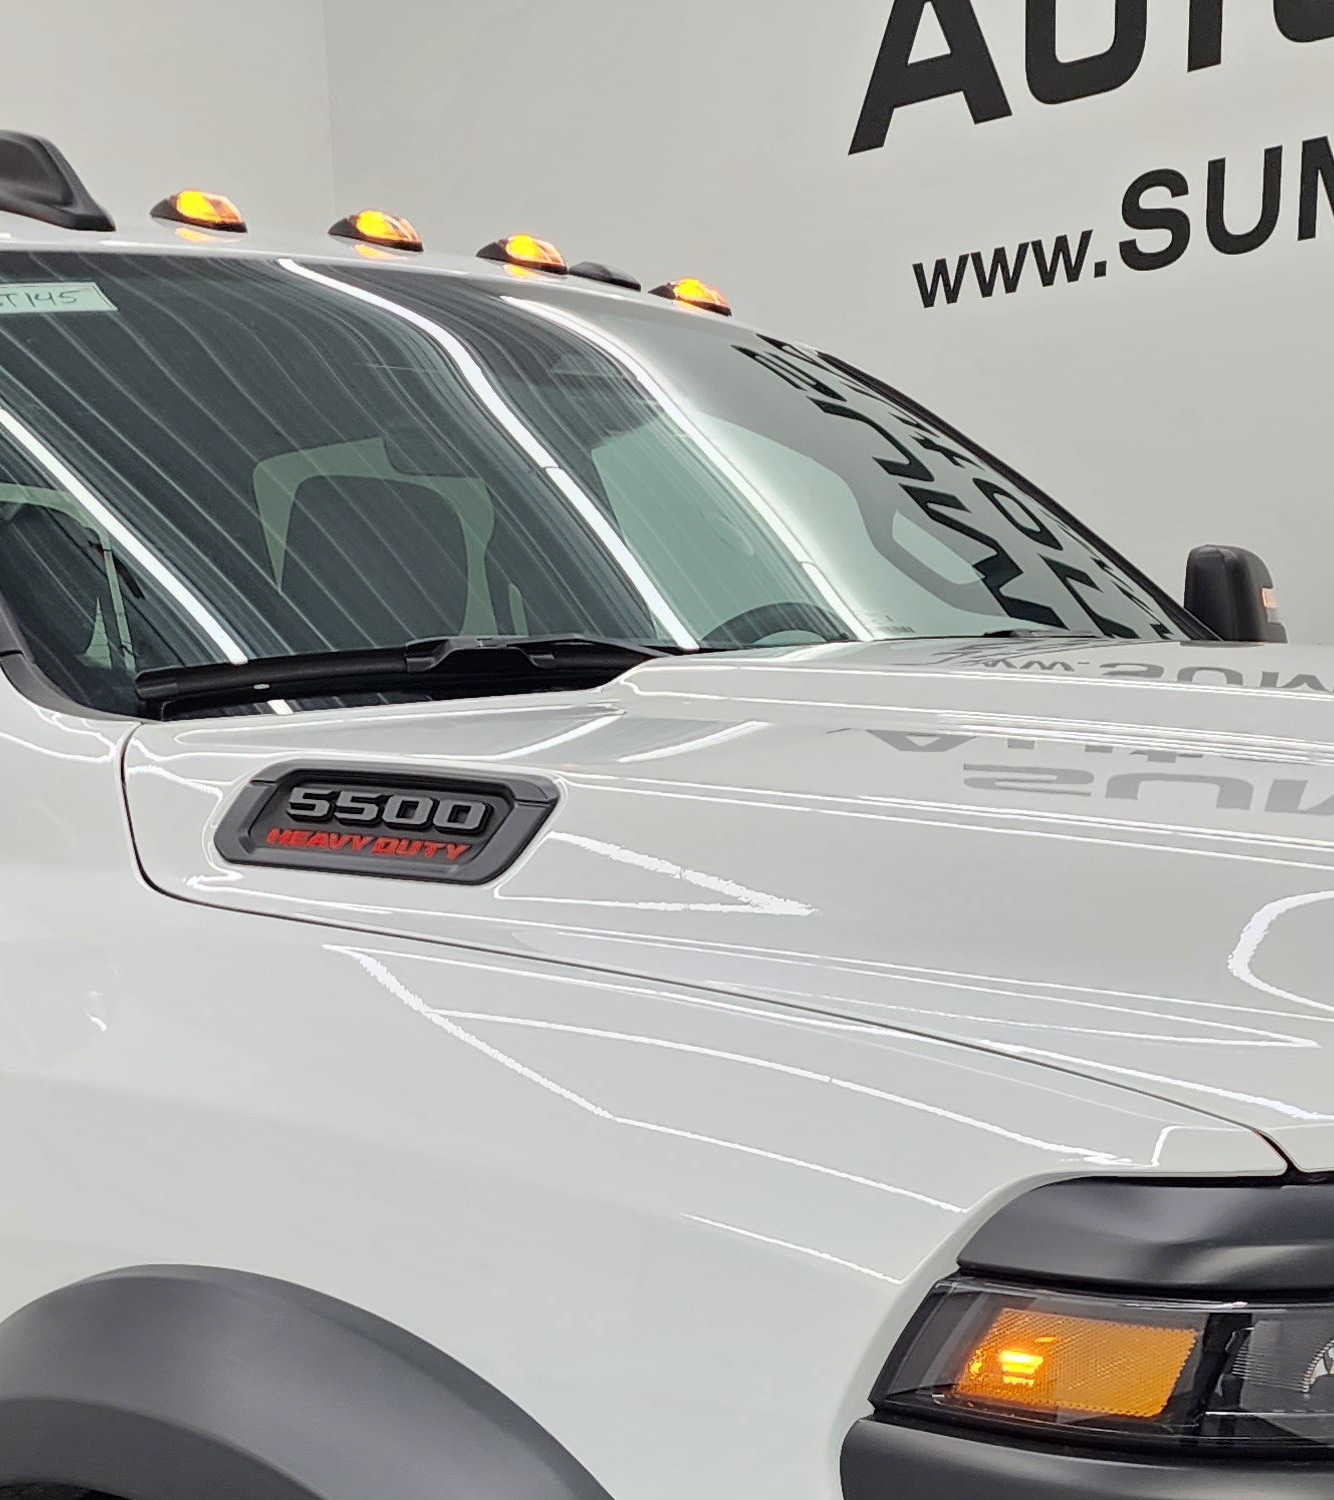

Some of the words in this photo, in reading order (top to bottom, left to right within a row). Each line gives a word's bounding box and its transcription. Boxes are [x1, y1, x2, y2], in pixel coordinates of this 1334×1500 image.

[285, 786, 495, 837] 5500
[267, 827, 375, 853] HEAVY
[371, 837, 471, 861] DUTY
